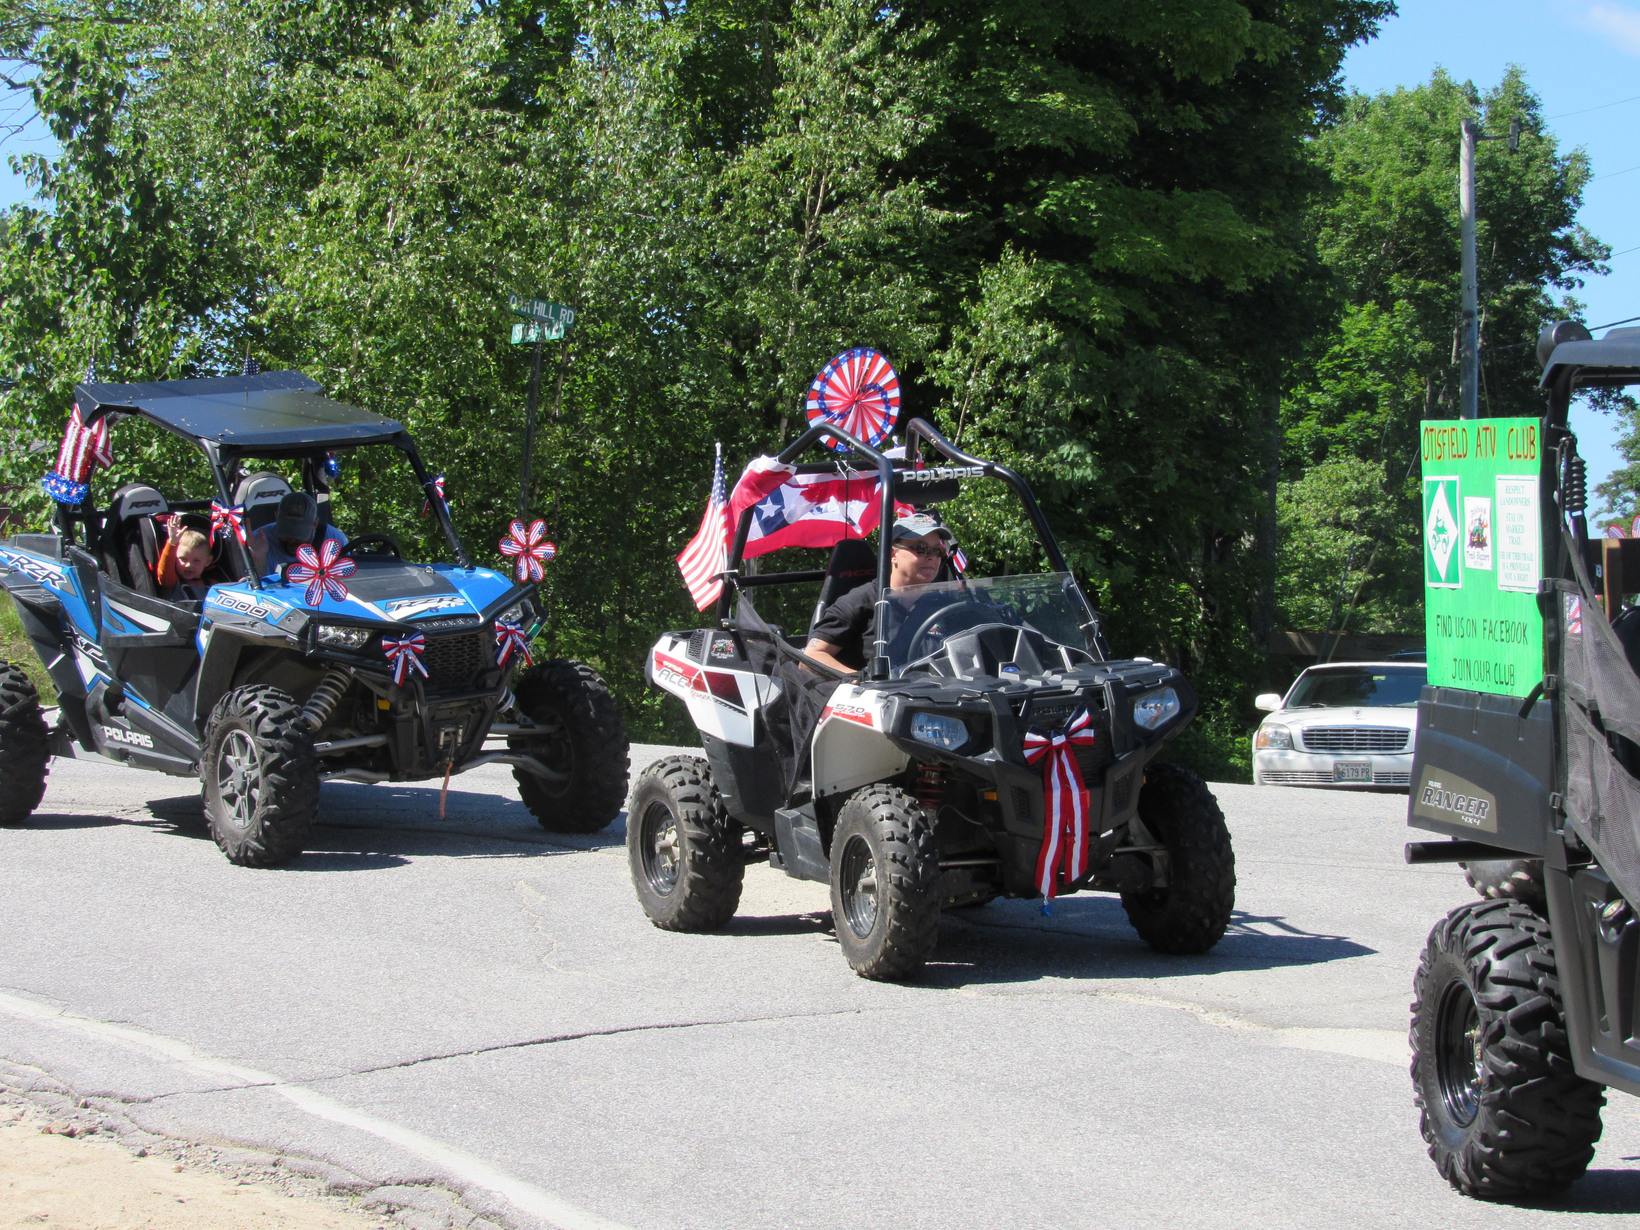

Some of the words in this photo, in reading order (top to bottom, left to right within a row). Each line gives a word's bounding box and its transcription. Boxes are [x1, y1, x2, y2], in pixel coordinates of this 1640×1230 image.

[533, 300, 555, 320] HILL
[560, 308, 575, 324] RD
[1422, 425, 1468, 461] OTISFIELD
[1475, 425, 1496, 459] ATV
[1507, 424, 1537, 461] CLUB
[902, 466, 985, 482] POLARIS
[255, 489, 286, 500] RZR
[8, 554, 67, 590] RZR
[214, 593, 271, 619] 1000
[1436, 614, 1452, 638] FIND
[1455, 616, 1465, 638] US
[1466, 618, 1477, 639] ON
[1482, 618, 1528, 645] FACEBOOK
[658, 668, 690, 689] ACE
[1452, 658, 1472, 681] JOIN
[1473, 660, 1491, 682] OUR
[1494, 662, 1515, 687] CLUB
[835, 703, 866, 714] 570
[103, 725, 154, 748] POLARIS
[1341, 767, 1359, 778] 6179
[1421, 786, 1490, 819] RANGER
